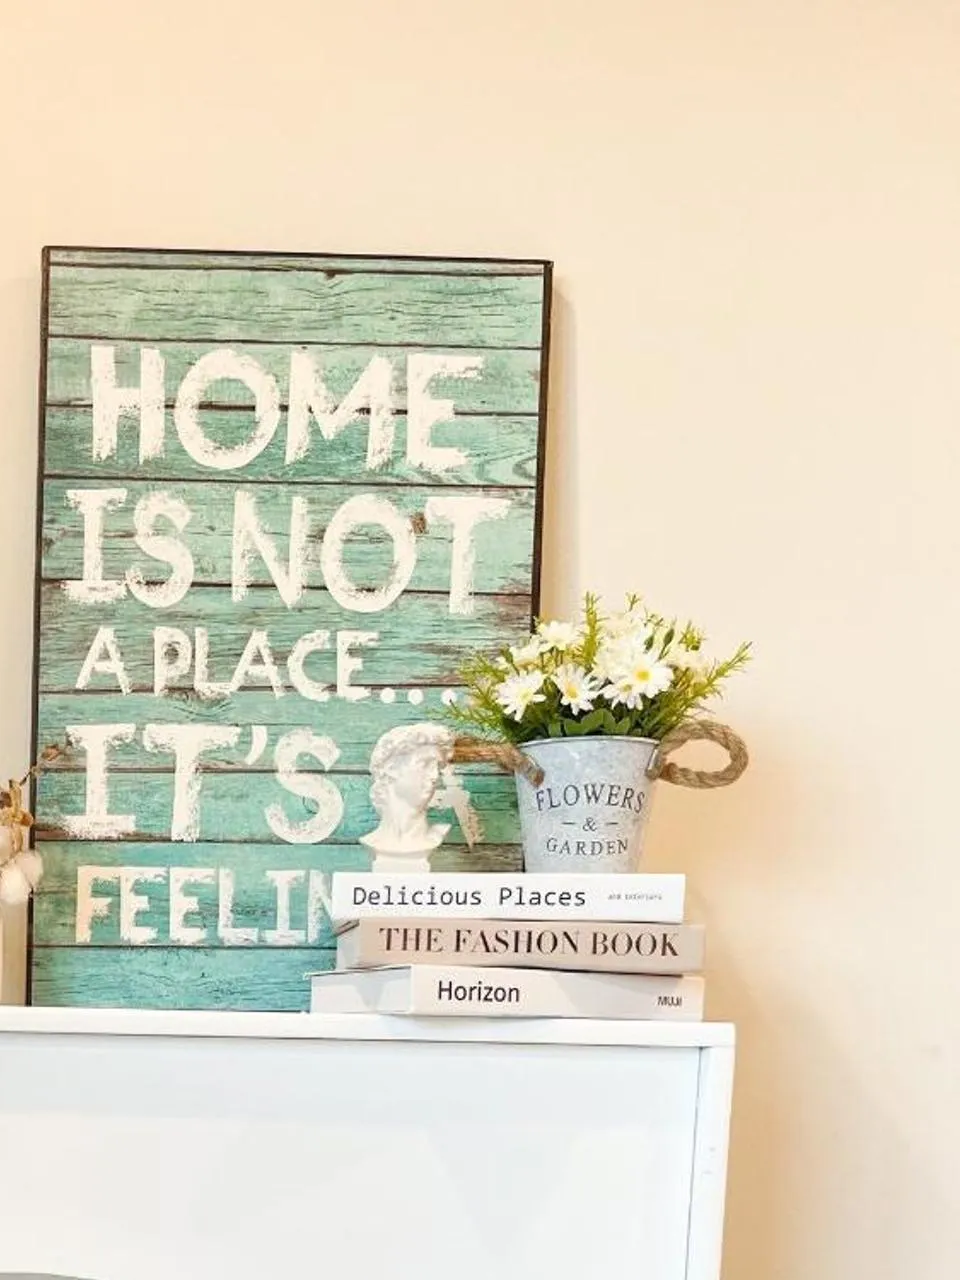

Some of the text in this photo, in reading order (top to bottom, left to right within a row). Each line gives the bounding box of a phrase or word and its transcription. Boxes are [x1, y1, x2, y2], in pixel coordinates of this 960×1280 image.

[90, 345, 486, 472] HOME
[60, 488, 514, 614] IS NOT
[75, 625, 133, 696] A
[62, 723, 344, 844] IT'S
[535, 783, 645, 813] FLOWERS
[546, 837, 628, 856] GARDEN
[352, 886, 587, 907] Delicious Places
[379, 926, 443, 953] THE
[591, 931, 680, 958] BOOK
[438, 980, 520, 1003] Horizon
